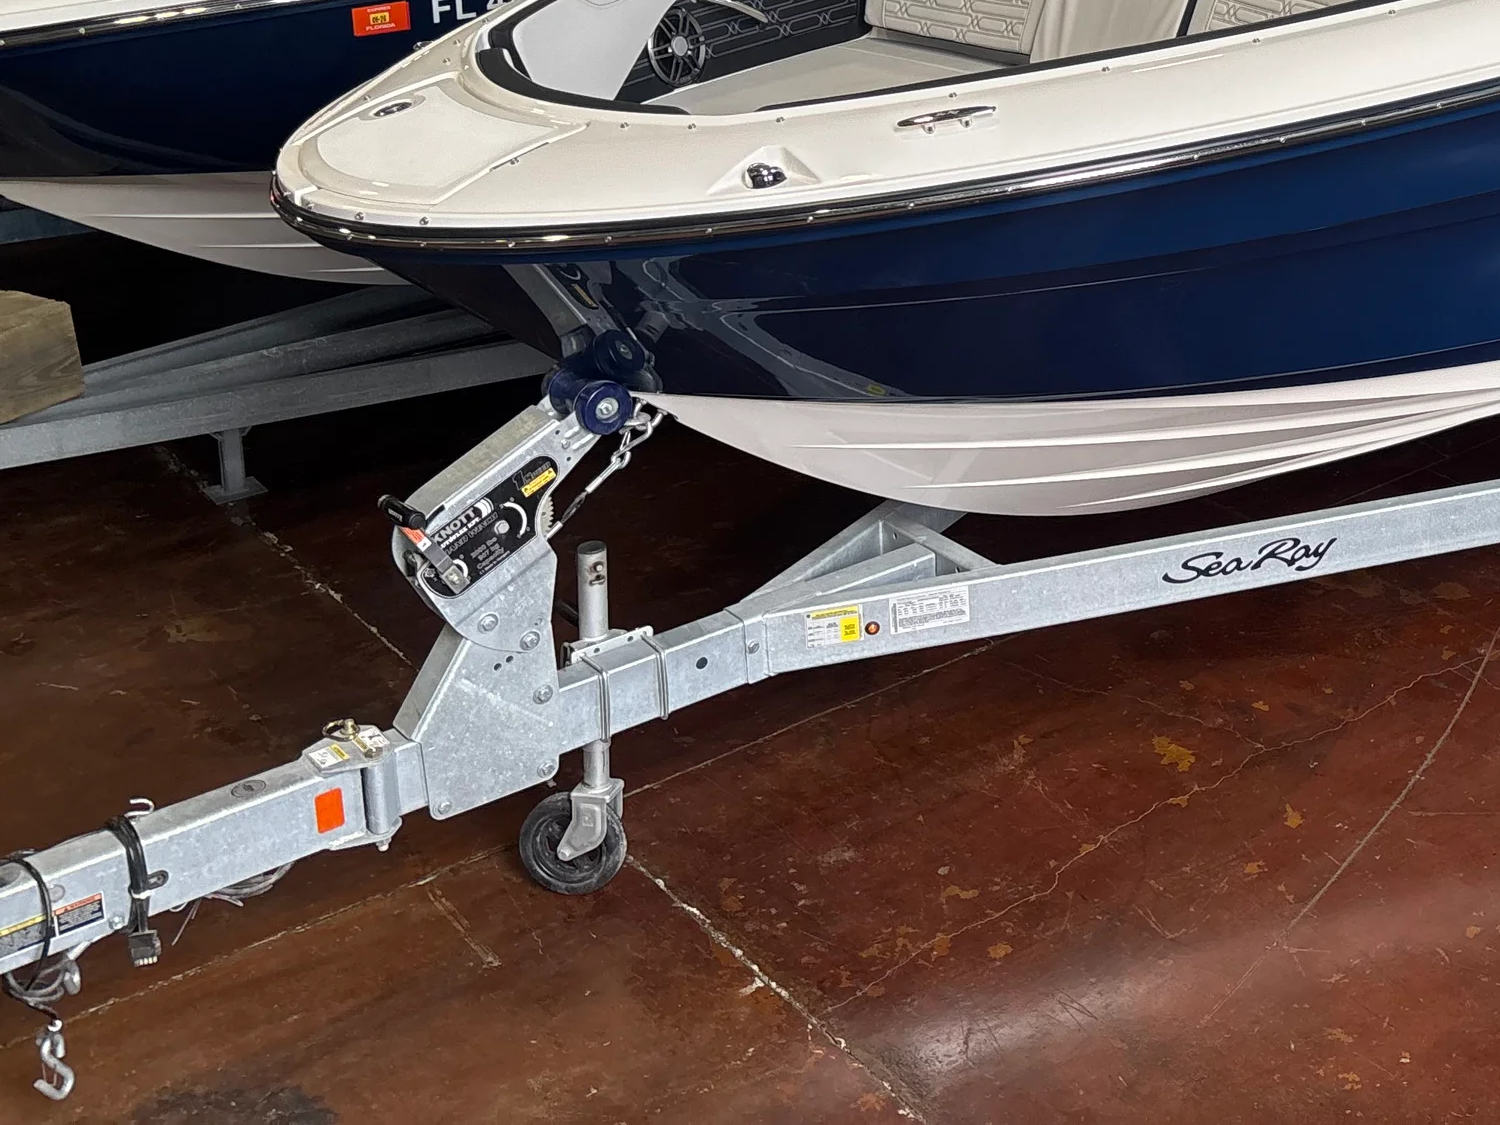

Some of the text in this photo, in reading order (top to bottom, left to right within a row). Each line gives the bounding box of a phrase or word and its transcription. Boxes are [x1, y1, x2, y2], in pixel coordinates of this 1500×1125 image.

[365, 23, 396, 32] FLORIDA
[434, 507, 476, 544] KNOTT
[1162, 537, 1338, 584] Sea Ray
